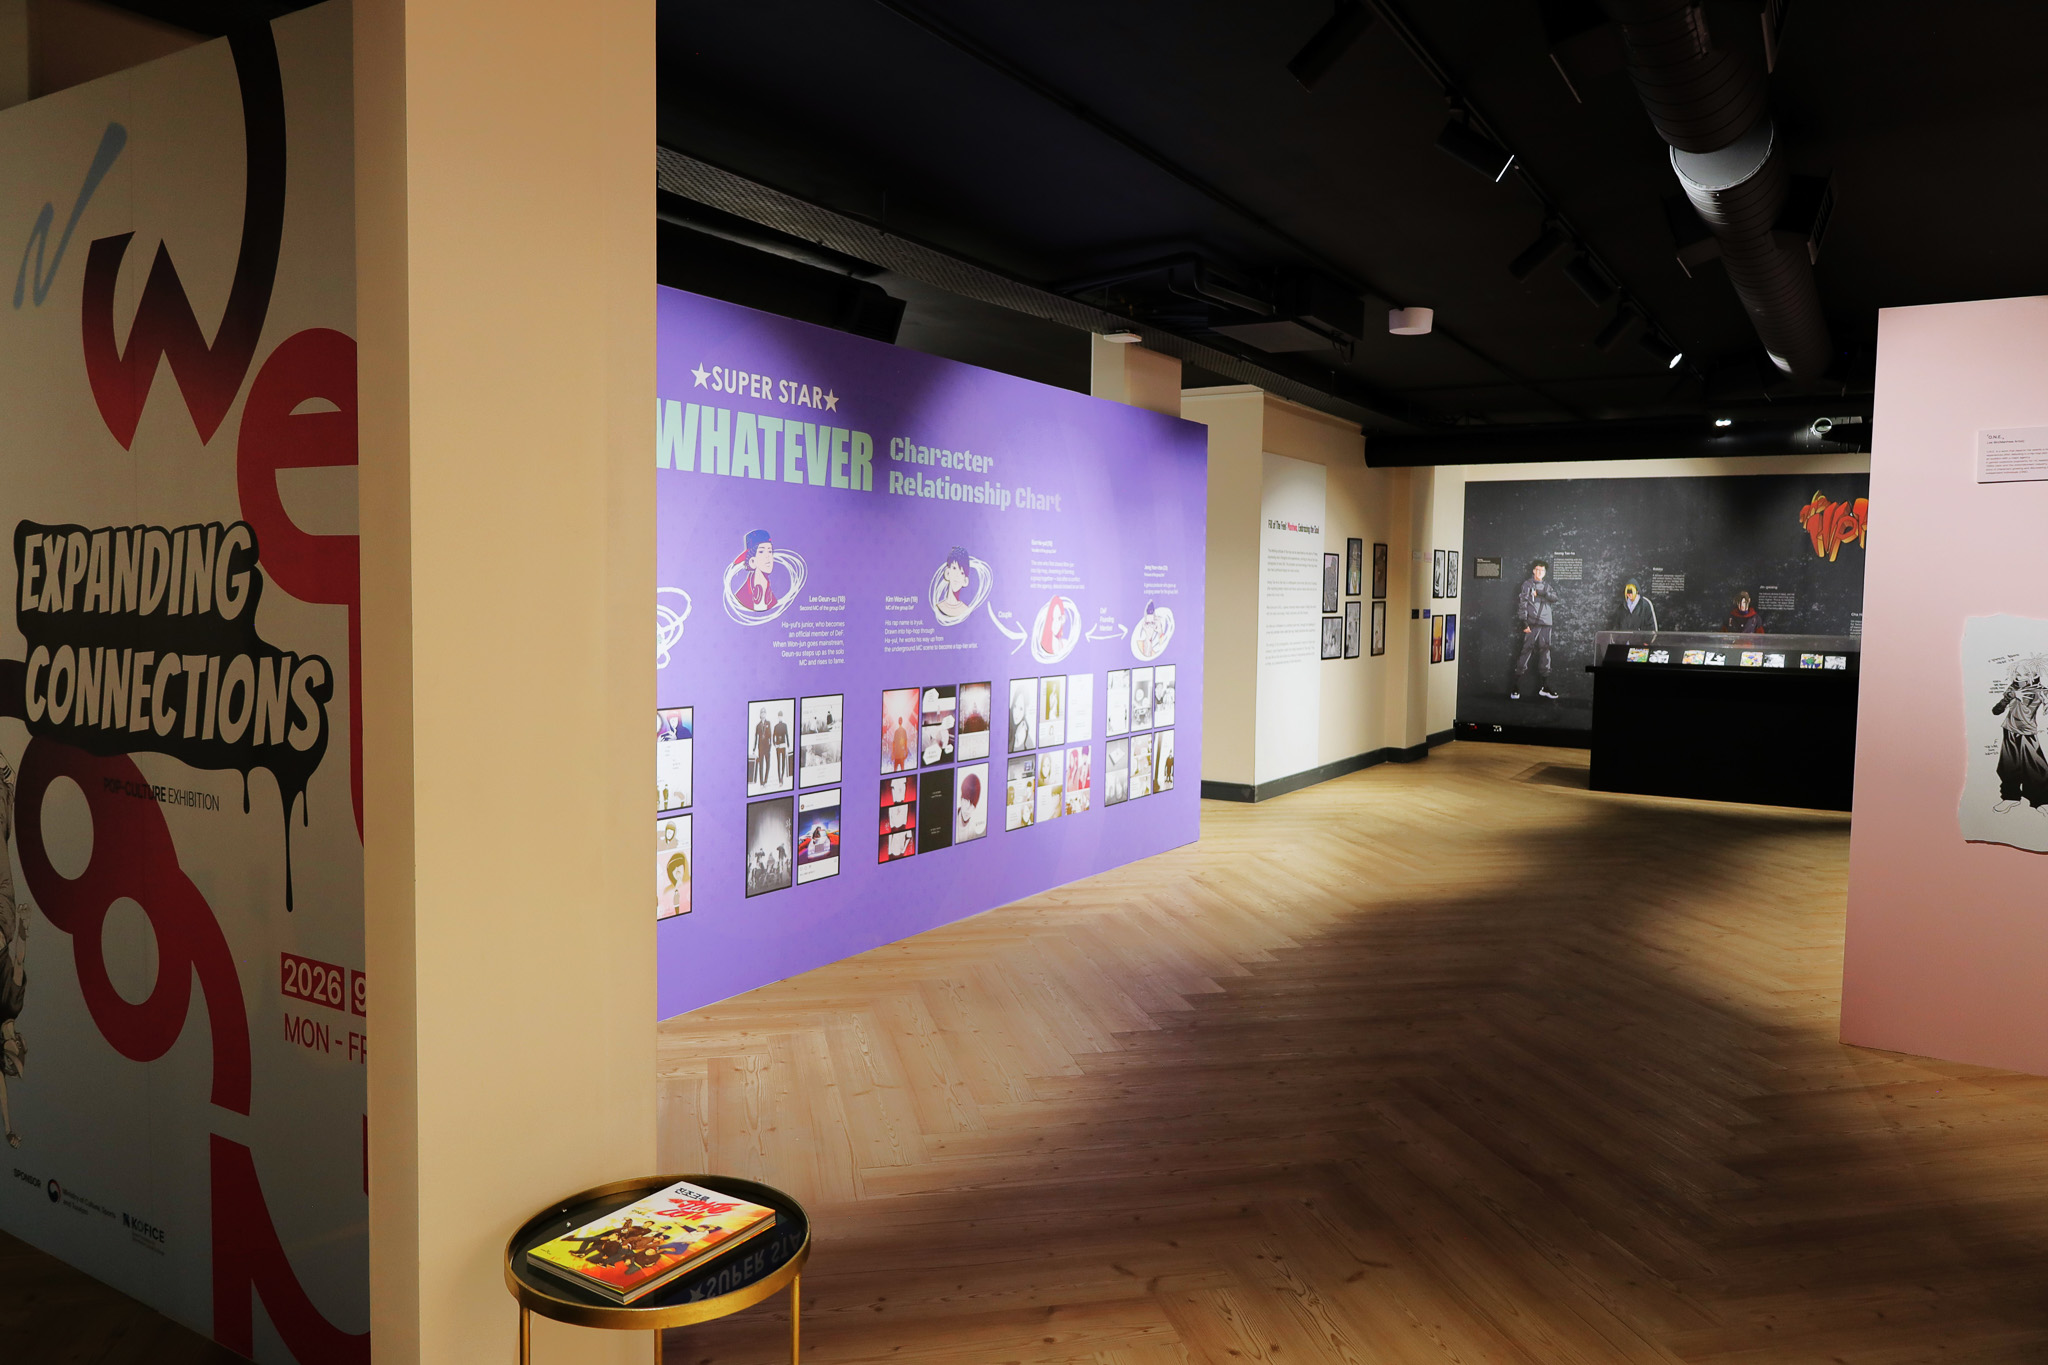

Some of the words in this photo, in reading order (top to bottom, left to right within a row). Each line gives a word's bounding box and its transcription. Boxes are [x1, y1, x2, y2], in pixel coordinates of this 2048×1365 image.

[711, 364, 773, 401] SUPER
[778, 378, 823, 409] STAR
[656, 397, 873, 491] WHATEVER
[890, 436, 994, 474] Character
[890, 470, 1011, 511] Relationship
[1015, 486, 1062, 512] Chart
[21, 525, 253, 621] EXPANDING
[892, 646, 915, 654] underground
[25, 644, 325, 751] CONNECTIONS
[104, 777, 166, 802] POP-CULTURE
[168, 788, 220, 811] EXHIBITION
[284, 958, 342, 1005] 2026
[284, 1013, 329, 1053] MON
[13, 1168, 42, 1190] SPONSOR
[131, 1216, 165, 1243] KOFICE
